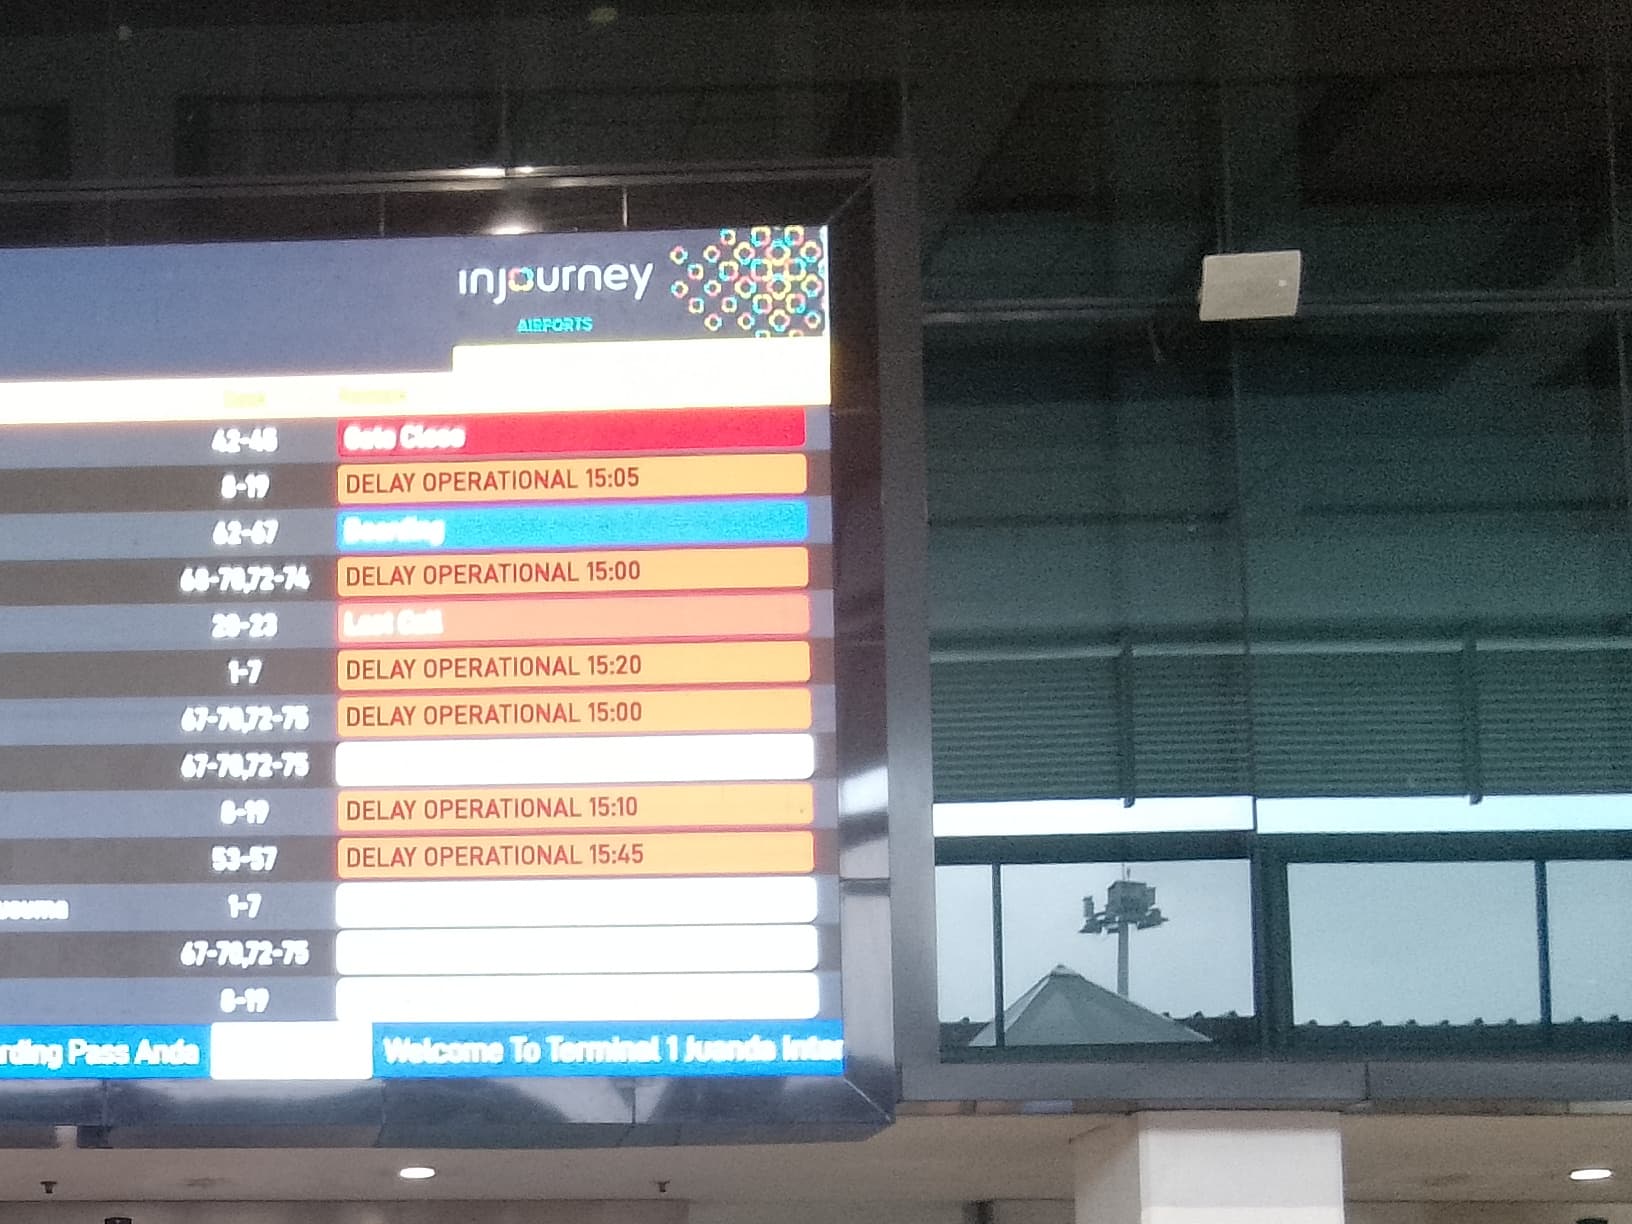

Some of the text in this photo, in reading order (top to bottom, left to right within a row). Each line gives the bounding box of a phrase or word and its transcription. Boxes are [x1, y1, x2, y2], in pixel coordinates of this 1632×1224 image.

[458, 262, 654, 305] injourney
[517, 316, 594, 334] AIRPORTS
[347, 473, 415, 493] DELAY
[423, 469, 577, 491] OPERATIONAL
[587, 467, 639, 488] 15:05
[347, 566, 415, 586] DELAY
[424, 562, 579, 584] OPERATIONAL
[587, 560, 640, 581] 15:00
[228, 659, 262, 684] 1-7
[347, 659, 415, 680] DELAY
[424, 656, 580, 678] OPERATIONAL
[588, 655, 641, 675] 15:20
[347, 706, 416, 726] DELAY
[424, 703, 580, 725] OPERATIONAL
[589, 702, 641, 722] 15:00
[347, 800, 416, 820] DELAY
[425, 798, 581, 819] OPERATIONAL
[590, 797, 637, 816] 15:10
[347, 847, 416, 867] DELAY
[425, 845, 581, 866] OPERATIONAL
[590, 844, 643, 864] 15:45
[227, 893, 262, 918] 1-7
[69, 1038, 130, 1065] Pass
[135, 1039, 200, 1065] Anda
[384, 1037, 504, 1064] Welcome
[511, 1036, 541, 1063] To
[548, 1036, 659, 1063] Terminal
[667, 1036, 678, 1061] 1
[686, 1035, 777, 1062] Juanda
